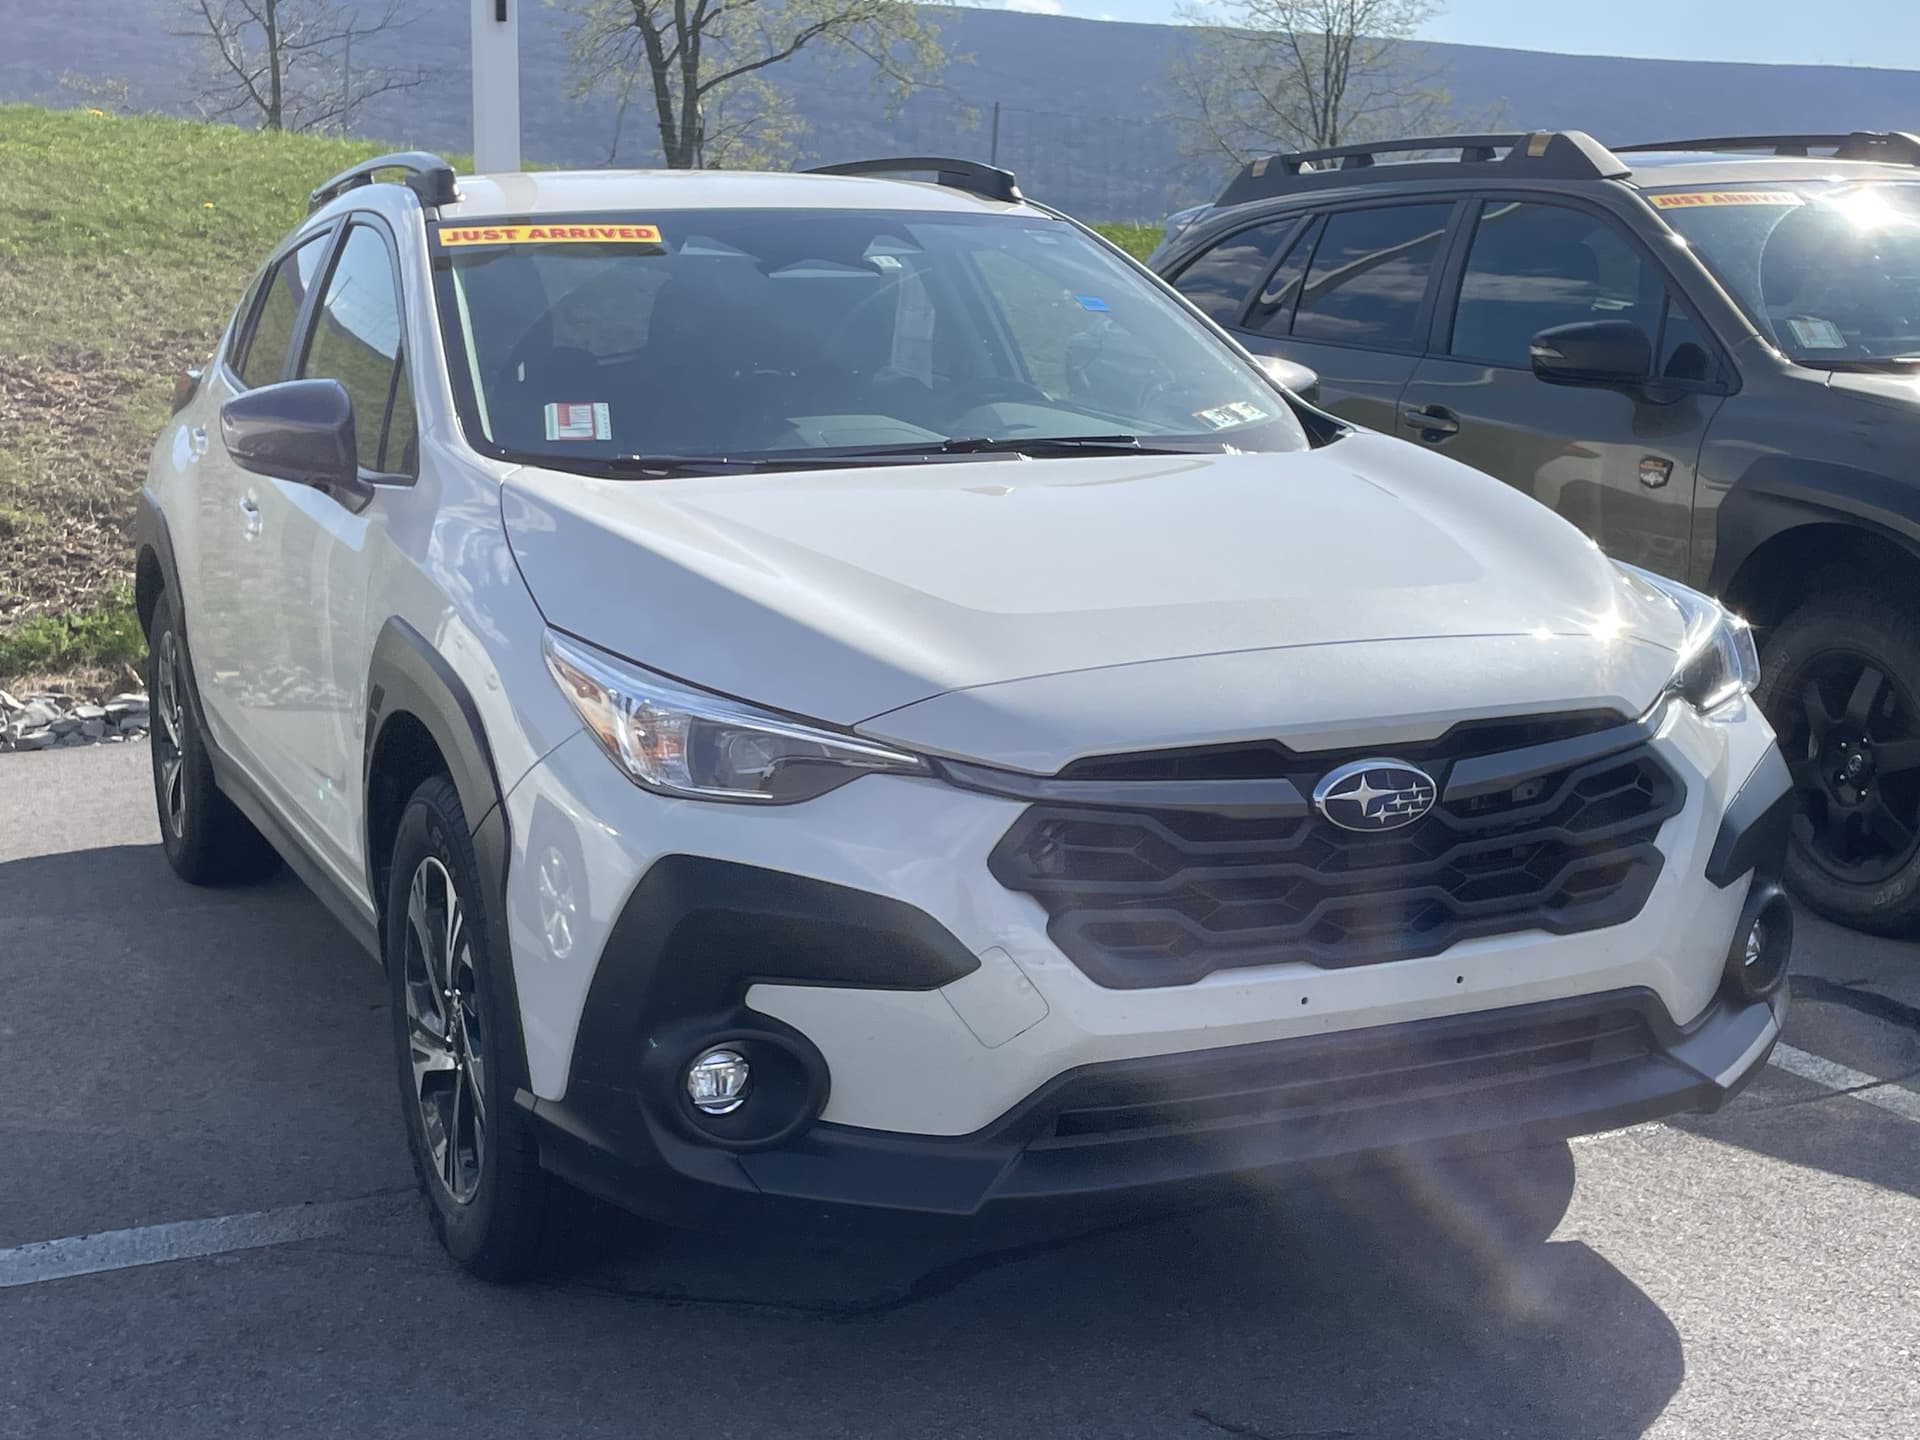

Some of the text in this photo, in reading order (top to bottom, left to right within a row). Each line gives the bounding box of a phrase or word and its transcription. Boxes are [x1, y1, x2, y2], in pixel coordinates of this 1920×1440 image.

[1659, 195, 1706, 206] JUST
[446, 229, 655, 242] JUST ARRIVED
